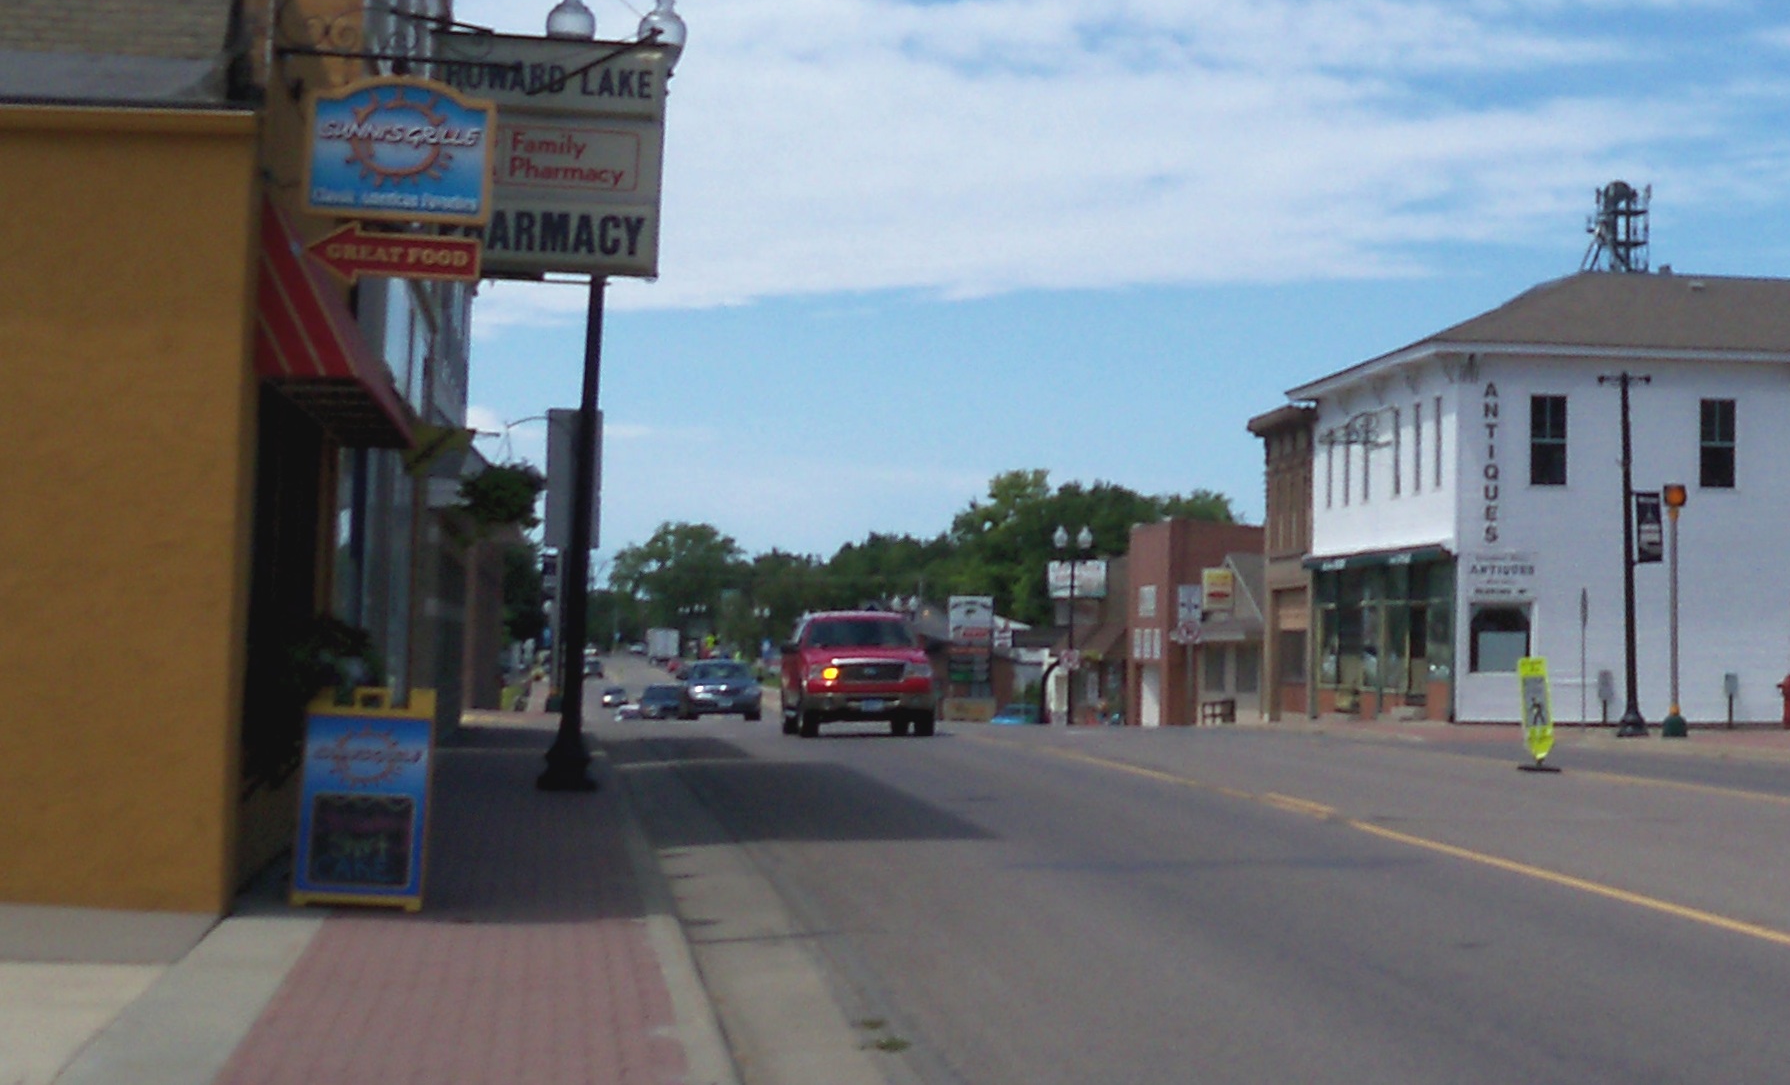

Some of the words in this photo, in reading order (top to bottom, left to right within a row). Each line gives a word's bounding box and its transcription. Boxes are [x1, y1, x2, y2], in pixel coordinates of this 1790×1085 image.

[580, 67, 653, 99] LAKE
[511, 131, 587, 159] Family
[509, 156, 624, 186] Pharmacy
[438, 210, 646, 257] ARMACY
[407, 247, 469, 266] FOOD
[1483, 382, 1500, 544] ANTIQUES
